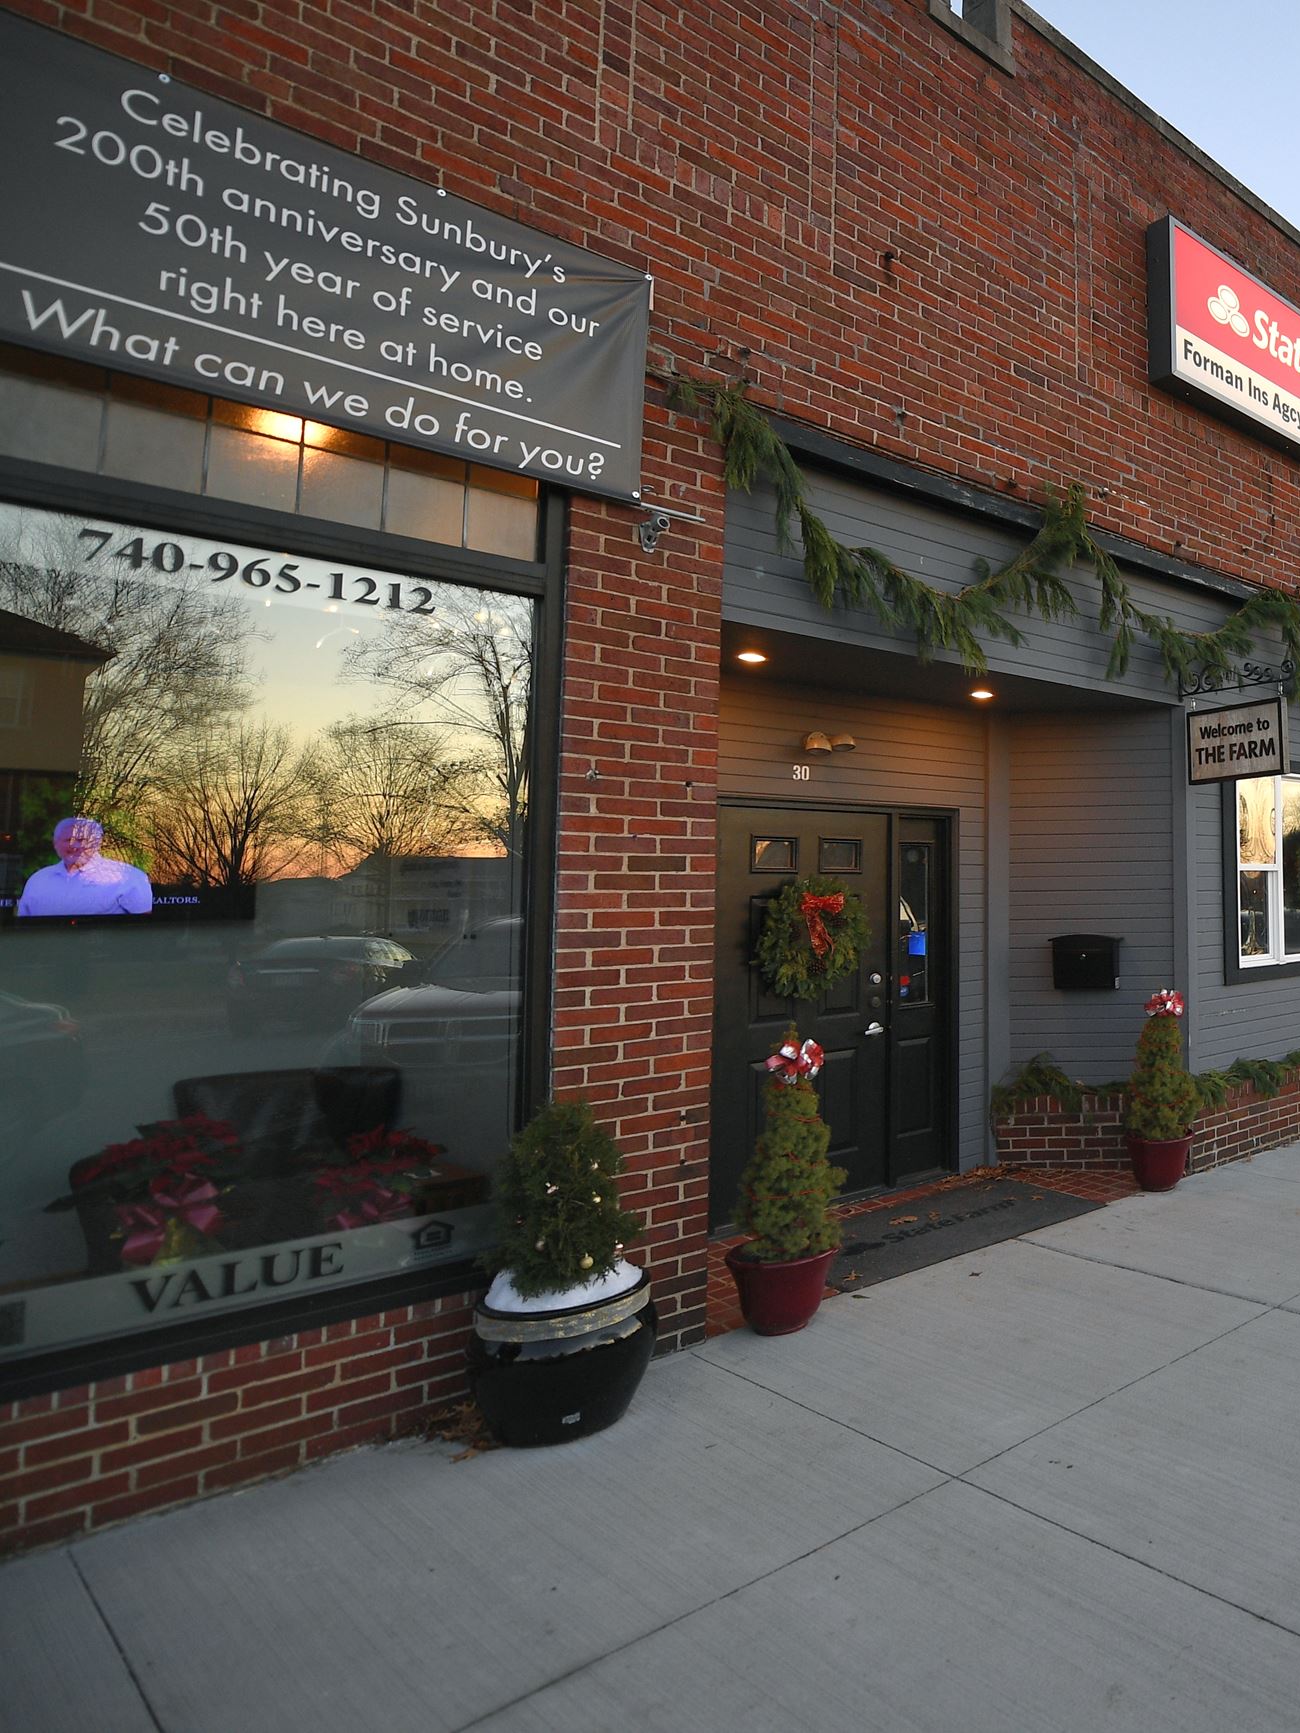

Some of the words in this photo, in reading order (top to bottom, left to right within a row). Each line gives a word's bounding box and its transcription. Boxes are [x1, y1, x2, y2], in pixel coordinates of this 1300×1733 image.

[53, 116, 205, 197] 200th
[222, 188, 460, 292] anniversary
[472, 272, 536, 317] and
[548, 306, 600, 337] our
[121, 89, 380, 217] Celebrating
[396, 196, 566, 284] Sunbury's
[139, 203, 248, 263] 50th
[263, 250, 361, 300] year
[373, 287, 412, 316] of
[423, 304, 543, 361] service
[159, 267, 263, 317] right
[277, 294, 366, 351] here
[379, 337, 417, 367] at
[428, 343, 533, 403] home.
[1183, 338, 1243, 392] Forman
[1248, 377, 1269, 406] Ins
[21, 289, 180, 366] What
[195, 352, 285, 396] can
[303, 378, 369, 417] we
[385, 398, 440, 435] do
[454, 413, 510, 454] for
[518, 441, 606, 479] you?
[78, 528, 436, 614] 740-965-1212
[1195, 745, 1225, 765] THE
[1229, 738, 1276, 762] FARM
[1200, 722, 1253, 740] Welcome
[1256, 718, 1270, 731] to
[792, 764, 810, 781] 30
[129, 1242, 345, 1313] VALUE
